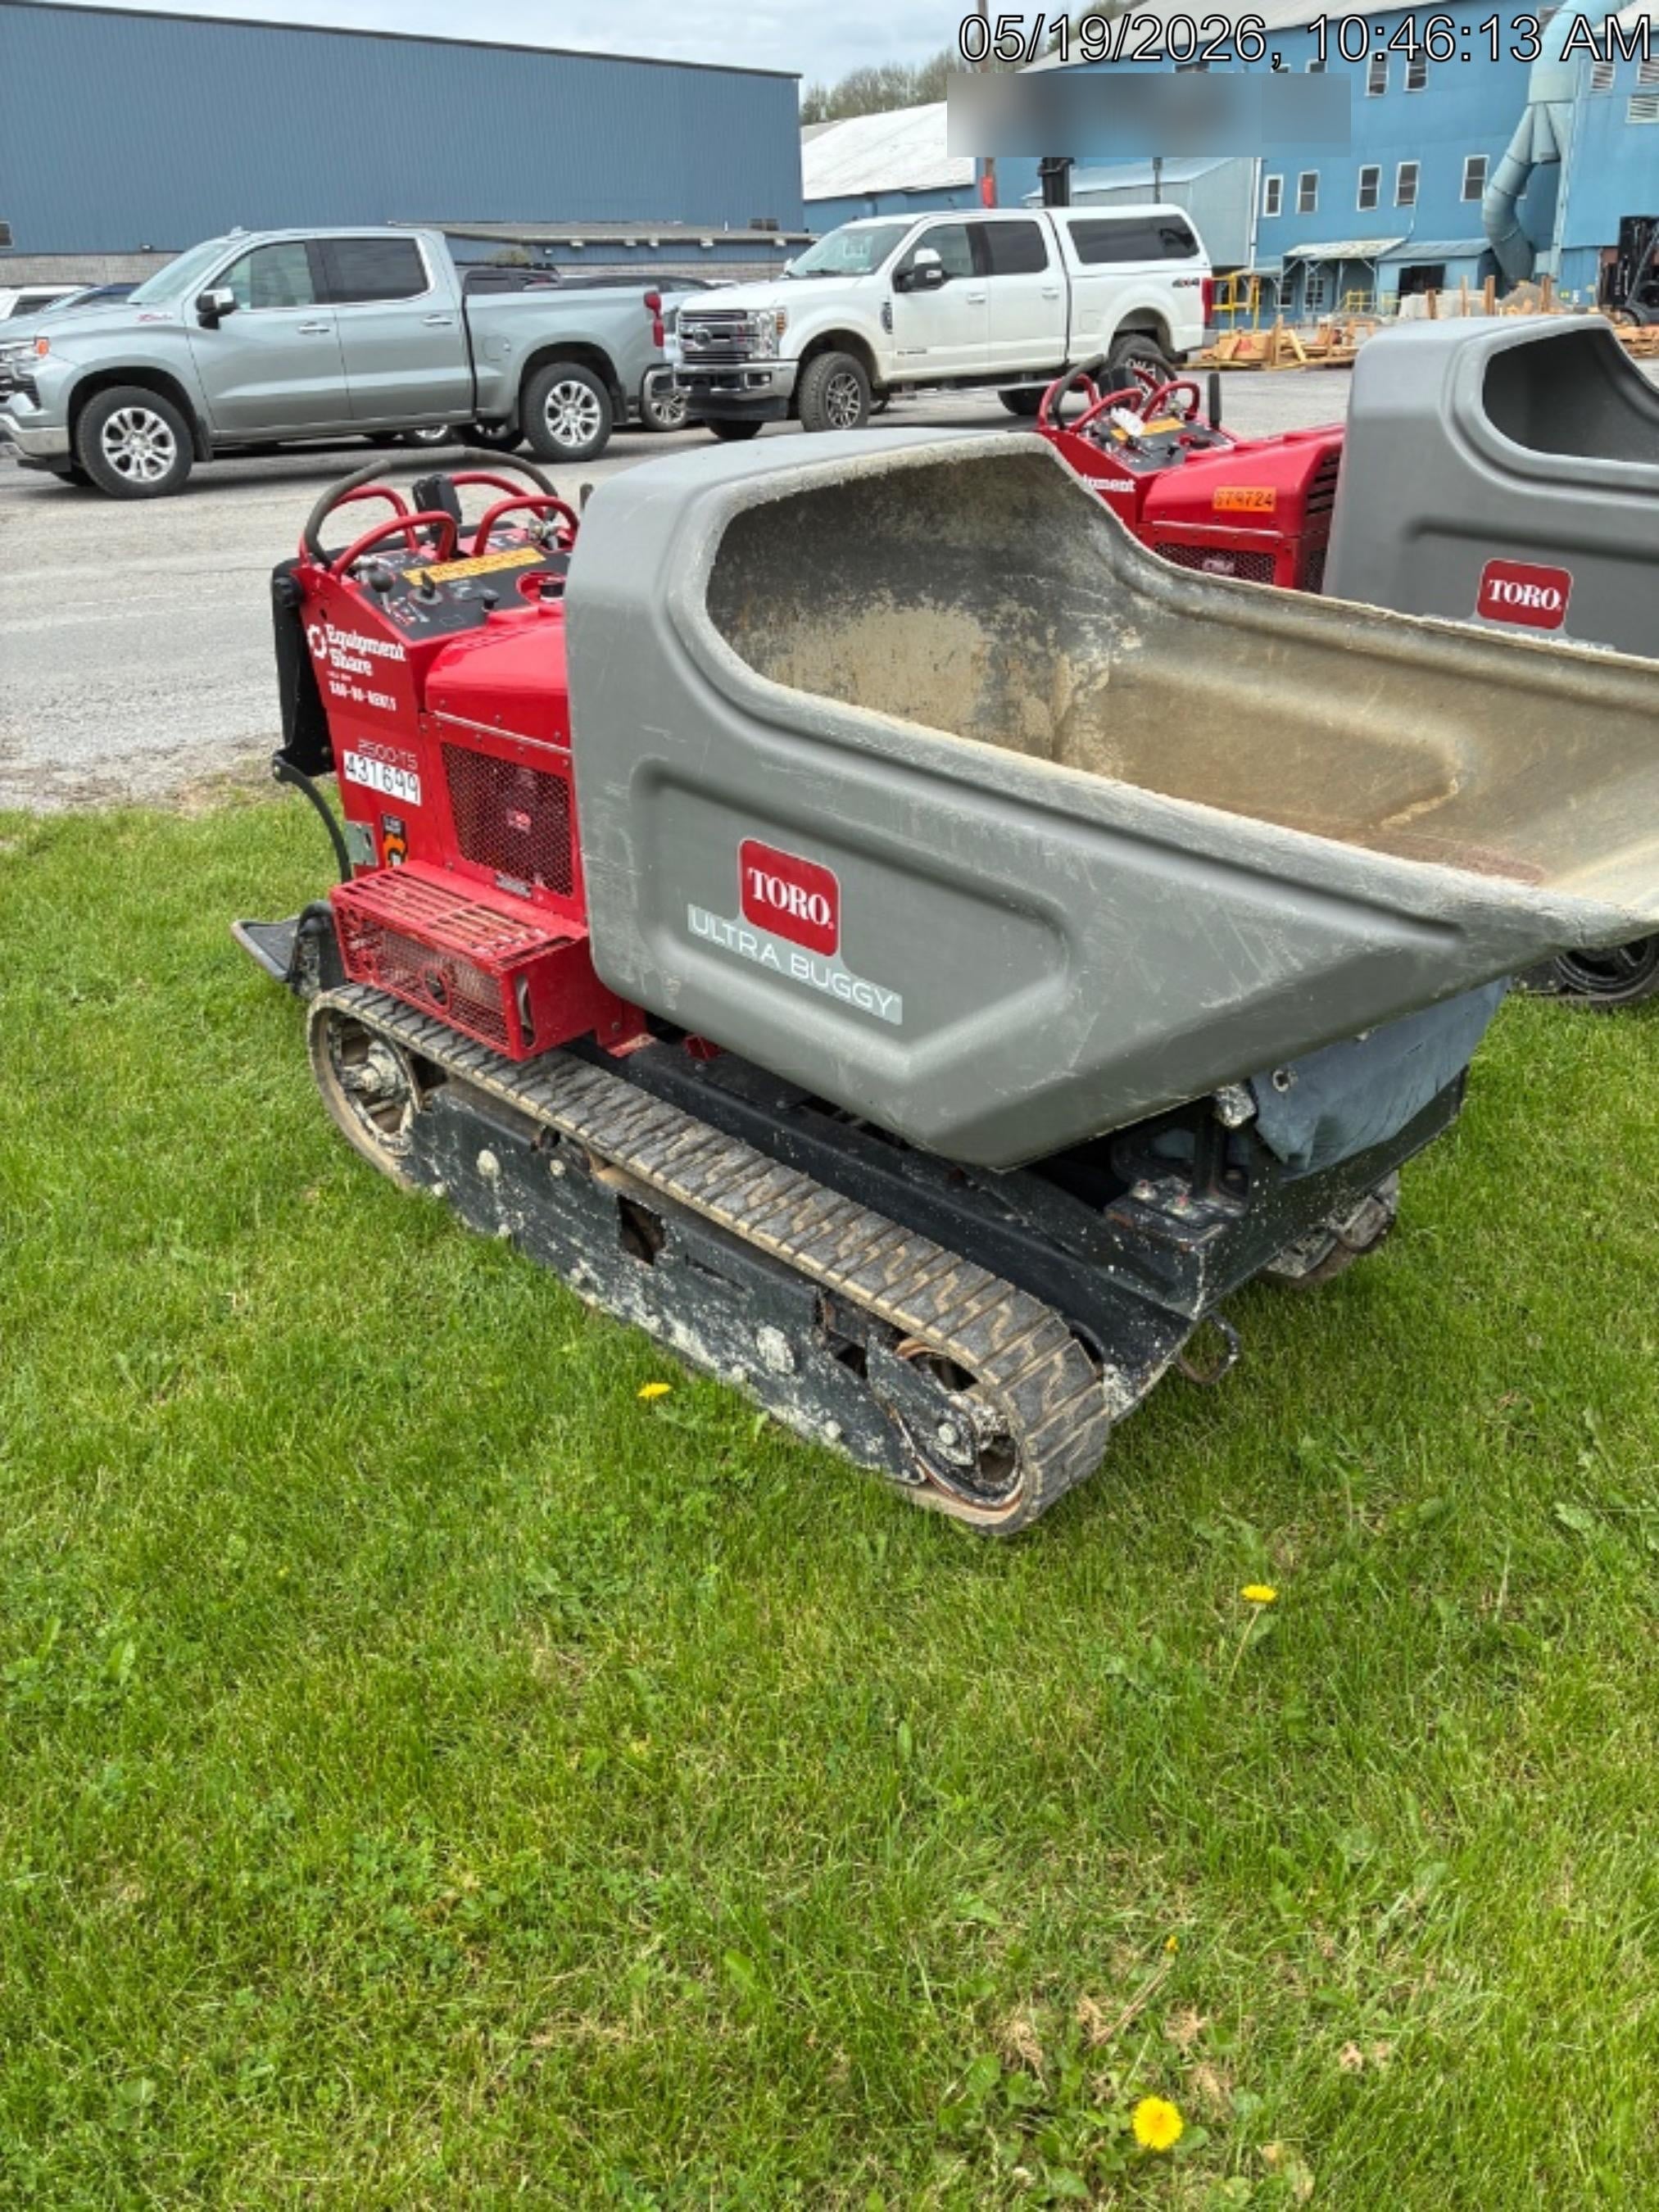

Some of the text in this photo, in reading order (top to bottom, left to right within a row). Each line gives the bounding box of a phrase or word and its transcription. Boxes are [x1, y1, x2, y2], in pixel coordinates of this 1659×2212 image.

[324, 623, 406, 662] Equipment
[329, 648, 374, 677] Share
[347, 753, 419, 802] 431699
[691, 908, 894, 1017] ULTRA BUGGY
